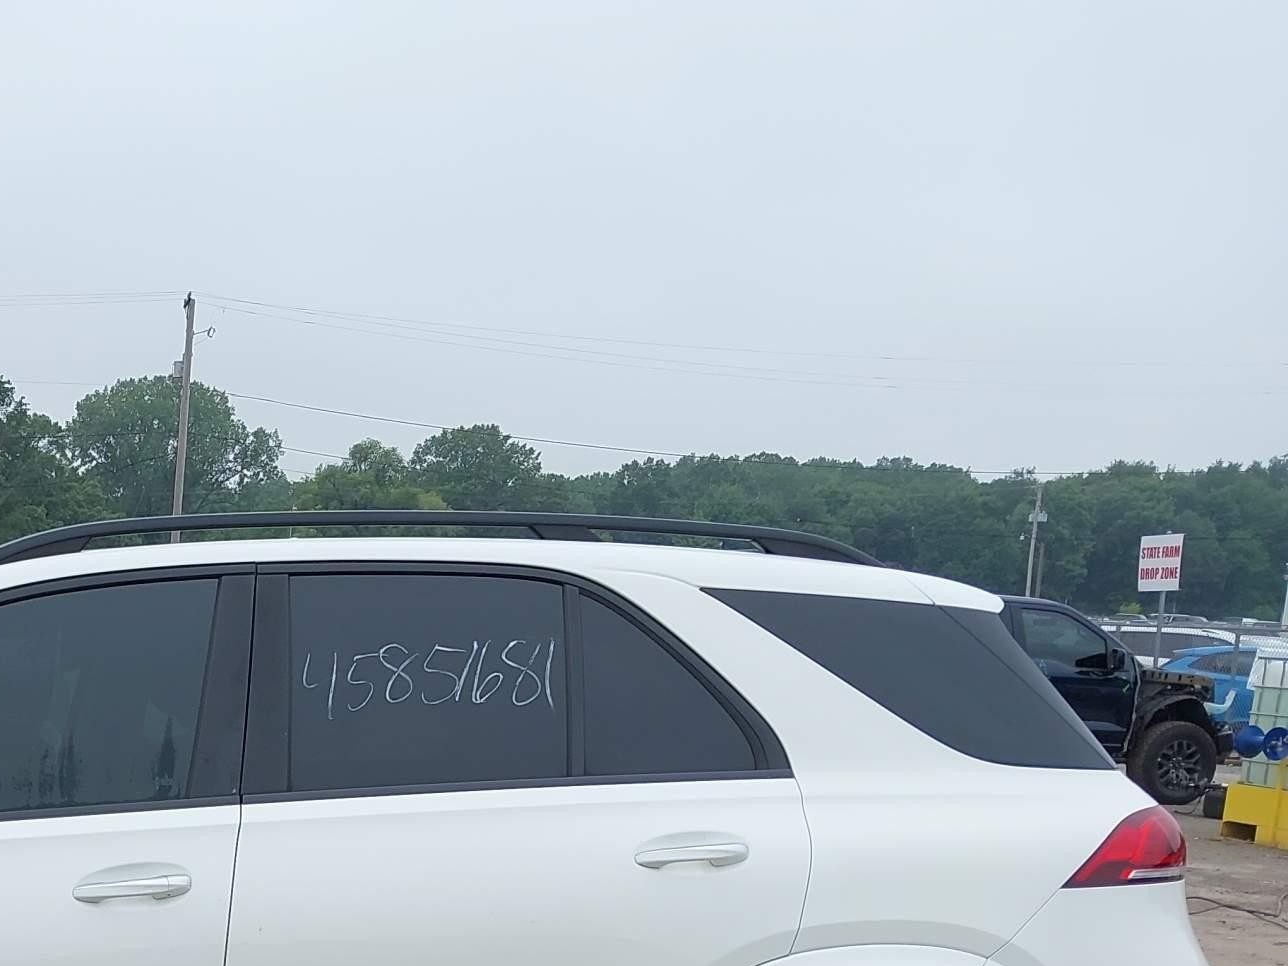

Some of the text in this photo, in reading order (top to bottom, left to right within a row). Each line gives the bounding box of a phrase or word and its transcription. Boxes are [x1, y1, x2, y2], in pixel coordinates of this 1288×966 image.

[1141, 545, 1181, 560] STATE FARM
[1140, 567, 1179, 580] DROP ZONE
[301, 637, 555, 720] 45851681
